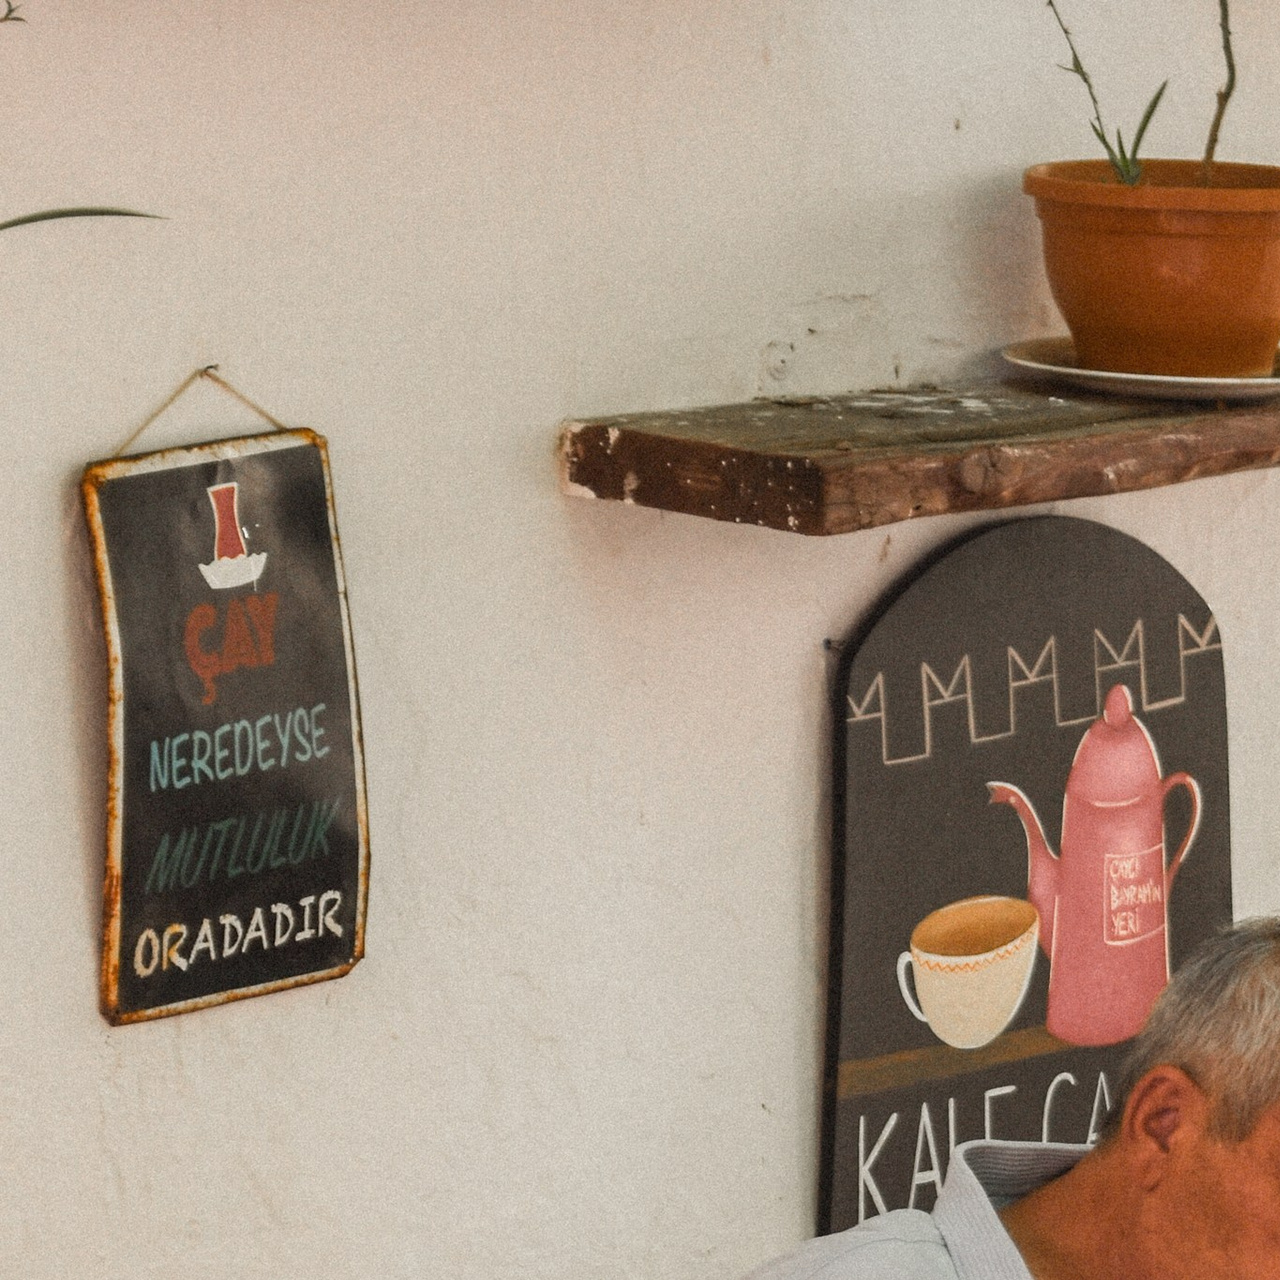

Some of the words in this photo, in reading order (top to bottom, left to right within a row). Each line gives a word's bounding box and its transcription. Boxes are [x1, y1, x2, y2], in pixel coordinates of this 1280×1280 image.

[186, 593, 279, 704] ÇAY
[150, 704, 330, 793] NEREDEYSE
[145, 802, 340, 894] MUTLULUK
[133, 890, 344, 978] ORADADIR
